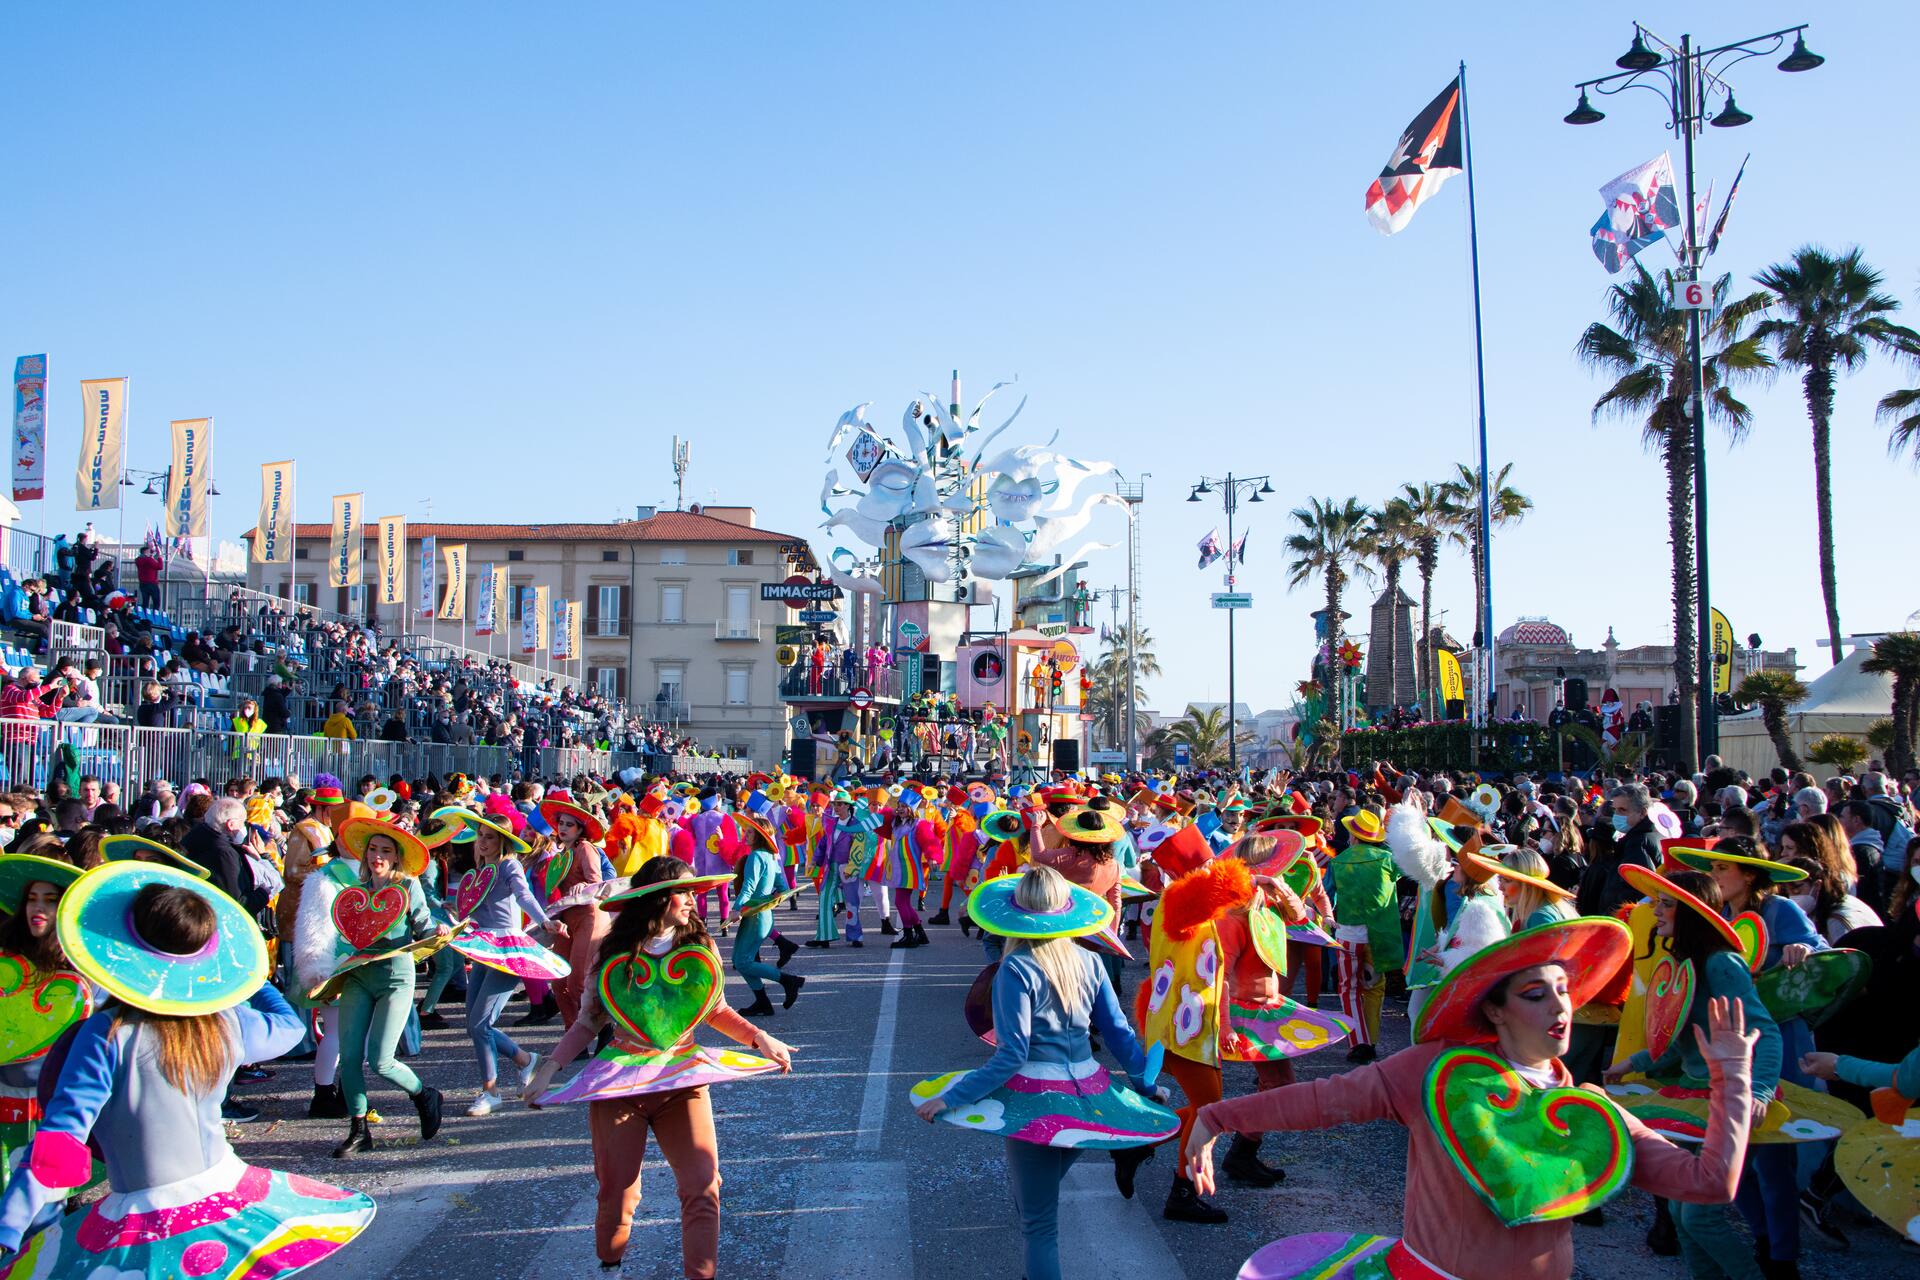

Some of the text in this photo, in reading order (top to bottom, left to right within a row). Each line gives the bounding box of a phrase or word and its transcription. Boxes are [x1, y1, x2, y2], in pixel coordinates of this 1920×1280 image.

[1685, 284, 1703, 305] 6
[1228, 575, 1235, 585] 5
[1051, 651, 1080, 663] Aurora
